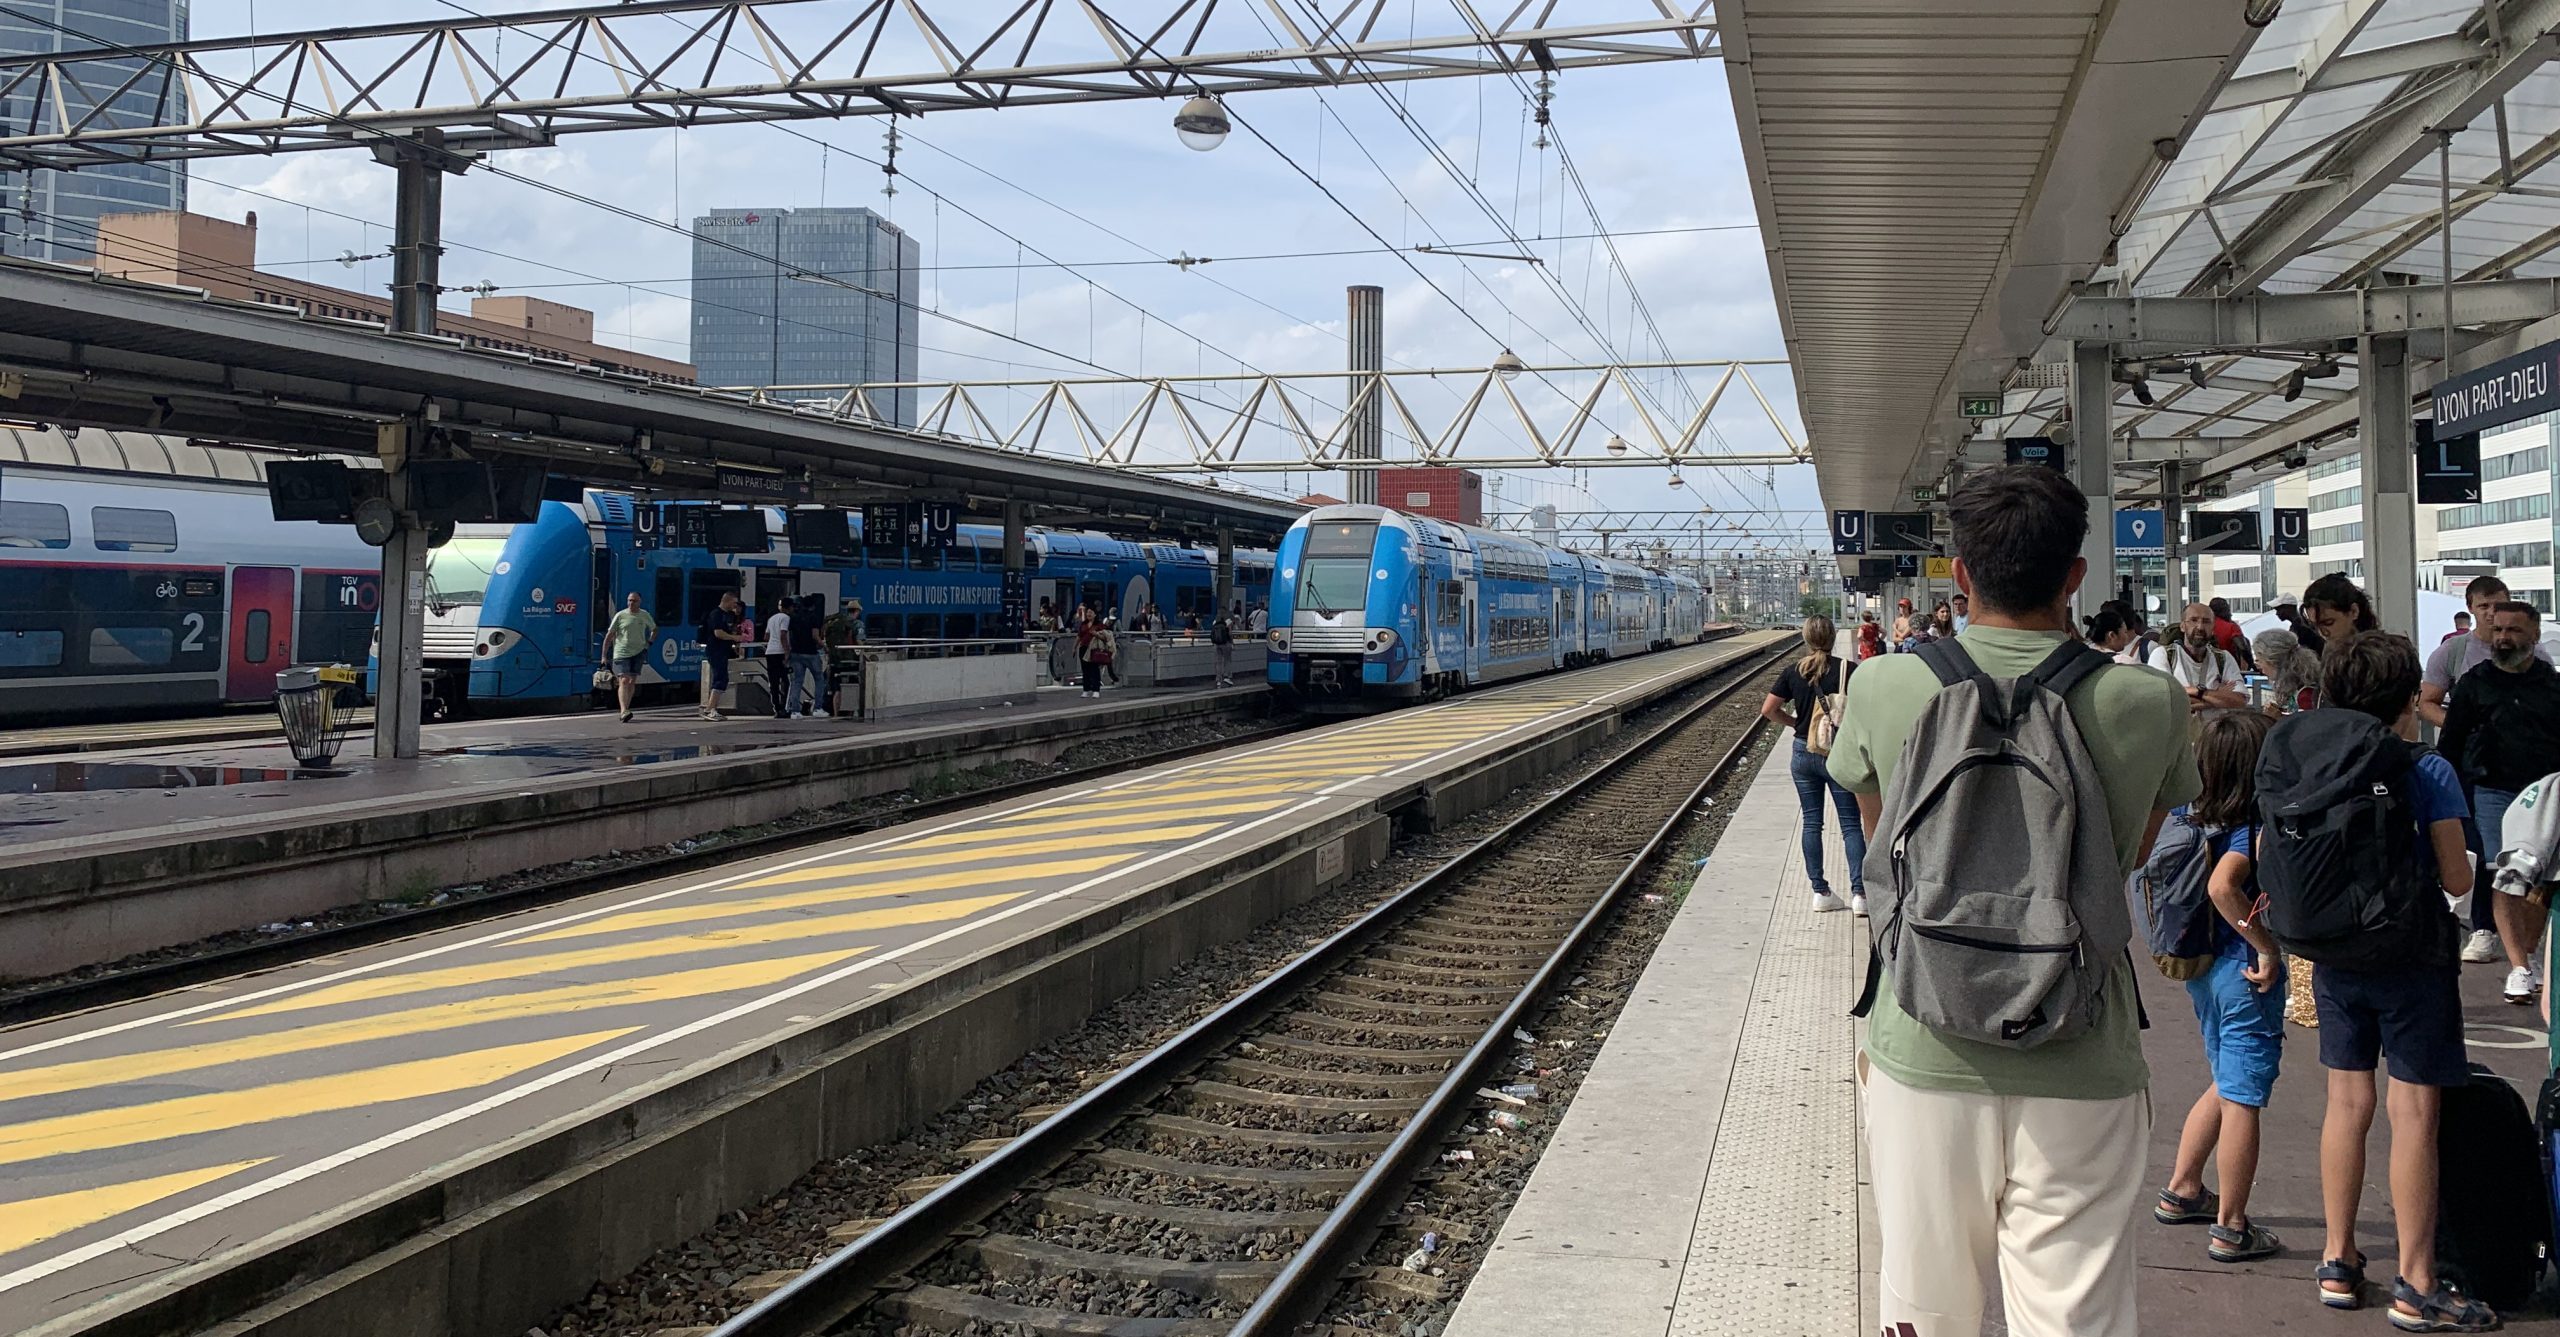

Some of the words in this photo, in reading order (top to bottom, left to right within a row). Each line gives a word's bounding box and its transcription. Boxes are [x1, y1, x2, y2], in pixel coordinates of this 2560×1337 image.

[2437, 389, 2469, 426] LYON
[2472, 361, 2548, 415] PART-DIEU
[2024, 448, 2046, 456] Voie
[2439, 443, 2461, 471] L
[722, 474, 744, 486] LYON
[745, 476, 783, 491] PART-DIEU
[639, 511, 654, 533] U
[934, 509, 950, 531] U
[1841, 516, 1858, 538] U
[2282, 516, 2300, 538] U
[1901, 554, 1911, 565] K
[342, 576, 358, 584] TGV
[1845, 577, 1853, 586] T
[873, 585, 886, 604] LA
[888, 581, 922, 605] RÉGION
[925, 586, 948, 605] VOUS
[949, 586, 1001, 605] TRANSPORTE
[555, 603, 576, 613] SNCF
[181, 613, 204, 652] 2
[681, 640, 690, 651] La
